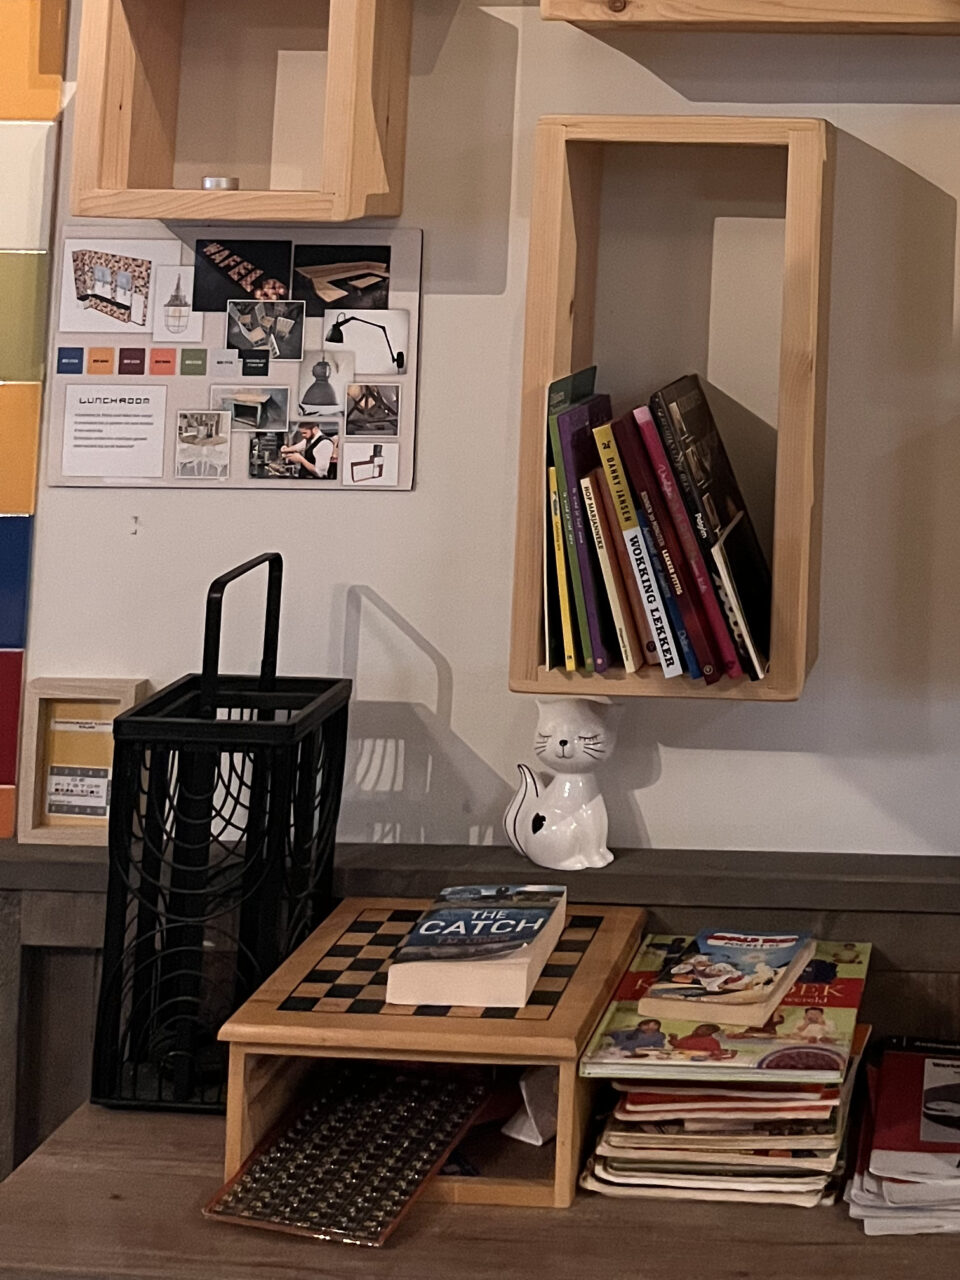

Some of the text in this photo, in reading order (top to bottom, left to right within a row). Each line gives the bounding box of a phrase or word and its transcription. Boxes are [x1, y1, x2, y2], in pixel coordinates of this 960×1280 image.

[79, 397, 150, 405] LUNCHROOM
[604, 456, 635, 524] DANNY JANSEN
[582, 485, 605, 550] HOP MARJANNEKE
[660, 548, 676, 574] LEKKER
[669, 573, 684, 596] PITTIG
[627, 534, 677, 669] WOKKING LEKKER
[419, 918, 545, 935] CATCH
[471, 910, 508, 920] THE
